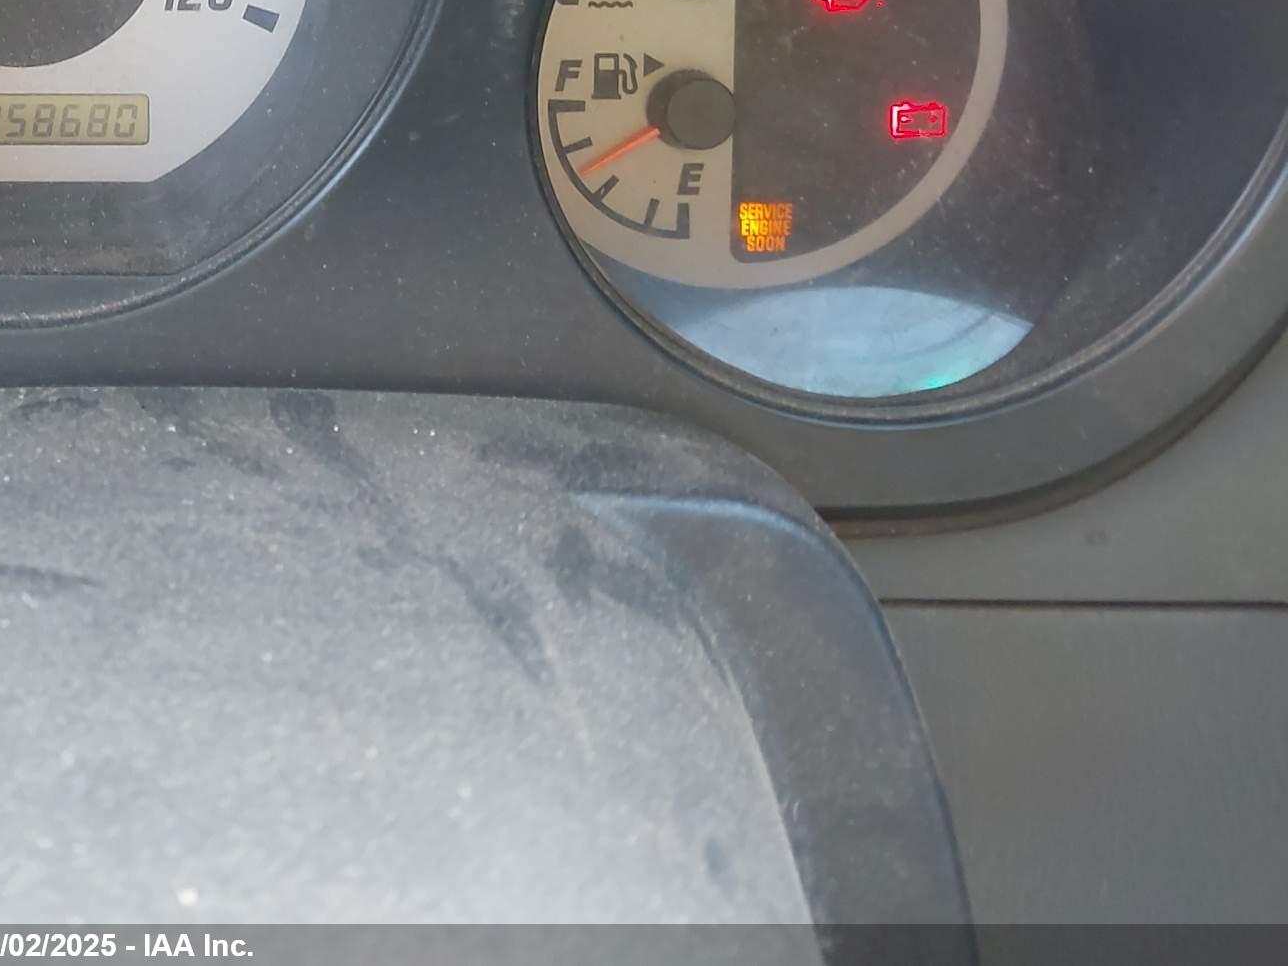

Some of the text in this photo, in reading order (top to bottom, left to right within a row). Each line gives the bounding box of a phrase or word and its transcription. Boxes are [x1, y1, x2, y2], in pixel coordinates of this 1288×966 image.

[555, 59, 584, 92] F
[677, 163, 705, 195] E
[738, 202, 794, 220] SERVICE
[740, 219, 793, 236] ENGINE
[746, 235, 786, 252] SOON
